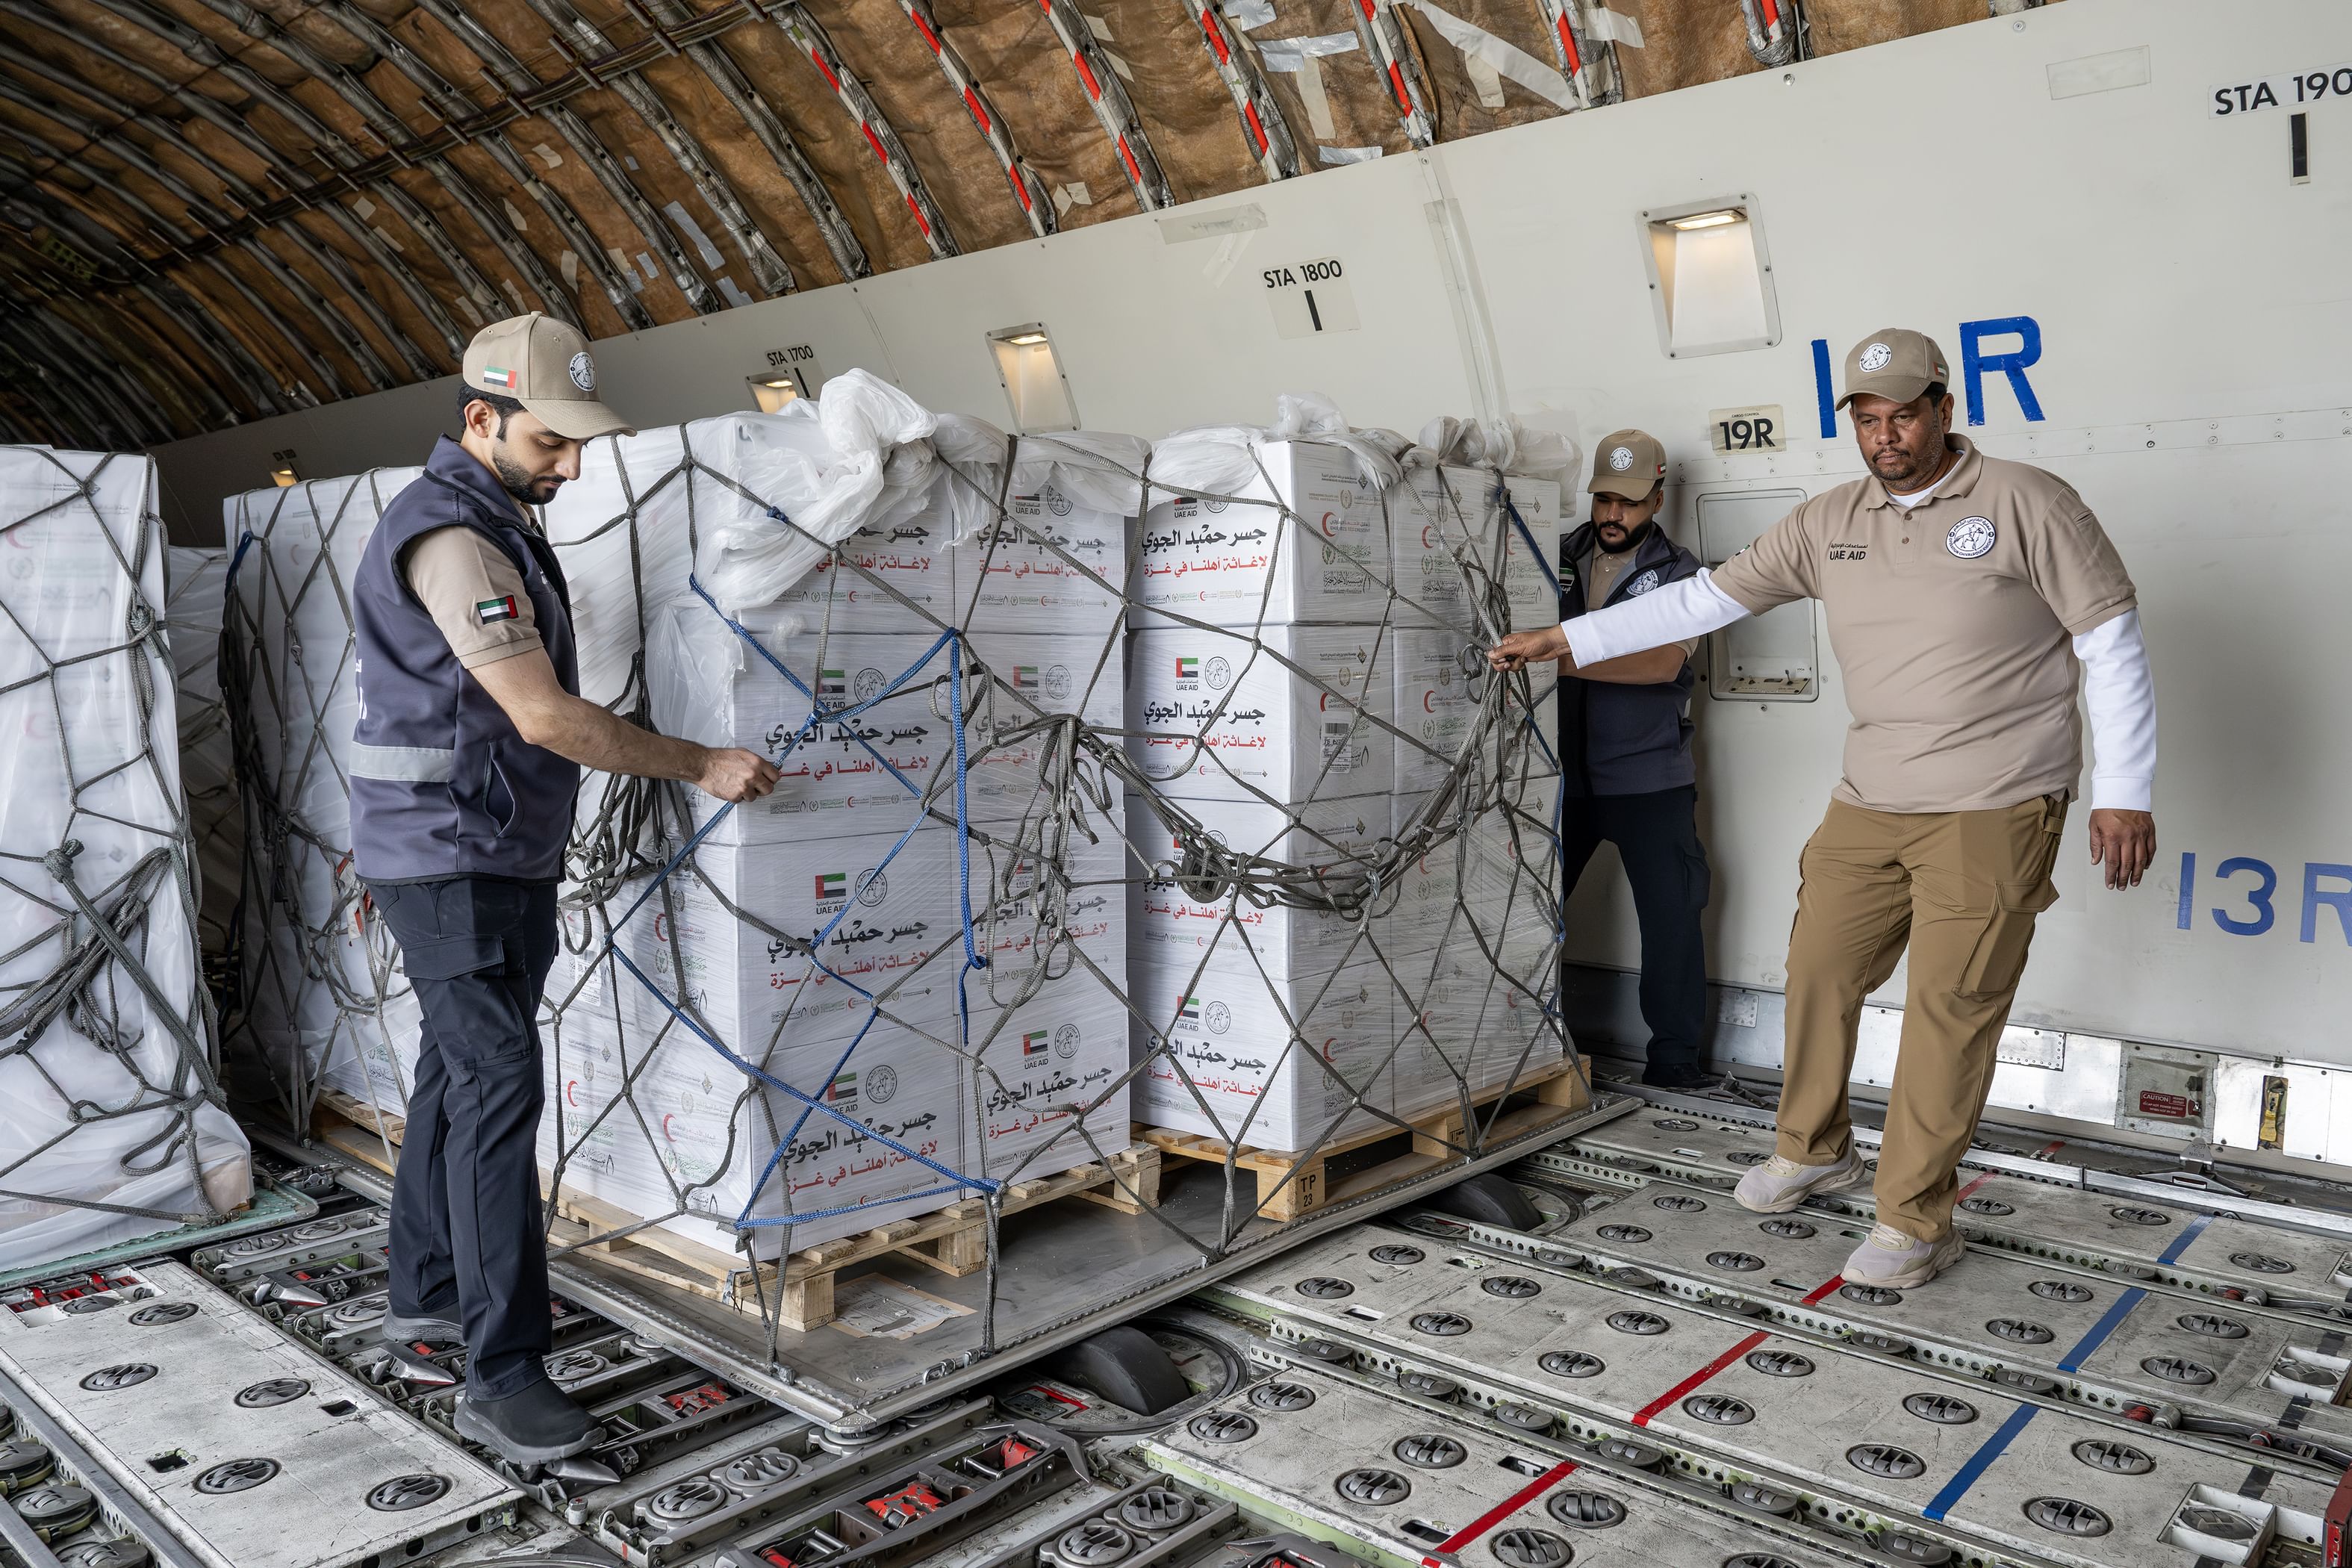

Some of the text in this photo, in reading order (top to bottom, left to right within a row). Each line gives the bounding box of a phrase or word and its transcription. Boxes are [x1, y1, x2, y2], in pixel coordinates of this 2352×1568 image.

[2215, 81, 2279, 116] STA
[1263, 260, 1342, 288] STA 1800
[767, 345, 814, 366] STA 1700
[1719, 418, 1776, 450] 19R
[1142, 529, 1180, 556] الجوي
[1228, 528, 1267, 546] جسر
[1191, 556, 1220, 571] أهلنا
[1829, 550, 1866, 560] UAE AID
[1144, 562, 1171, 578] غزة
[1175, 561, 1187, 578] في
[1144, 700, 1182, 725] الجوي
[1228, 709, 1266, 726] جسر
[883, 726, 929, 745] جسر
[814, 761, 833, 781] في
[837, 756, 875, 772] أهلنا
[1144, 900, 1171, 914] غزة
[2177, 852, 2352, 947] 13R
[816, 906, 833, 915] UAE
[1173, 904, 1186, 920] في
[1189, 906, 1217, 919] أهلنا
[883, 921, 929, 943] جسر
[1177, 1022, 1199, 1032] UAE AID
[1024, 1058, 1048, 1069] UAE AID
[1148, 1065, 1173, 1080] غزة
[1228, 1056, 1266, 1075] جسر
[1077, 1068, 1112, 1089] جسر
[2142, 1094, 2169, 1102] CAUTION
[835, 1104, 858, 1114] AE AID
[895, 1113, 937, 1137] جسر
[989, 1119, 1021, 1139] غزة
[1024, 1114, 1038, 1133] في
[850, 1152, 887, 1175] أهلنا
[828, 1166, 846, 1187] في
[1300, 1175, 1316, 1192] TP
[1303, 1193, 1313, 1207] 23
